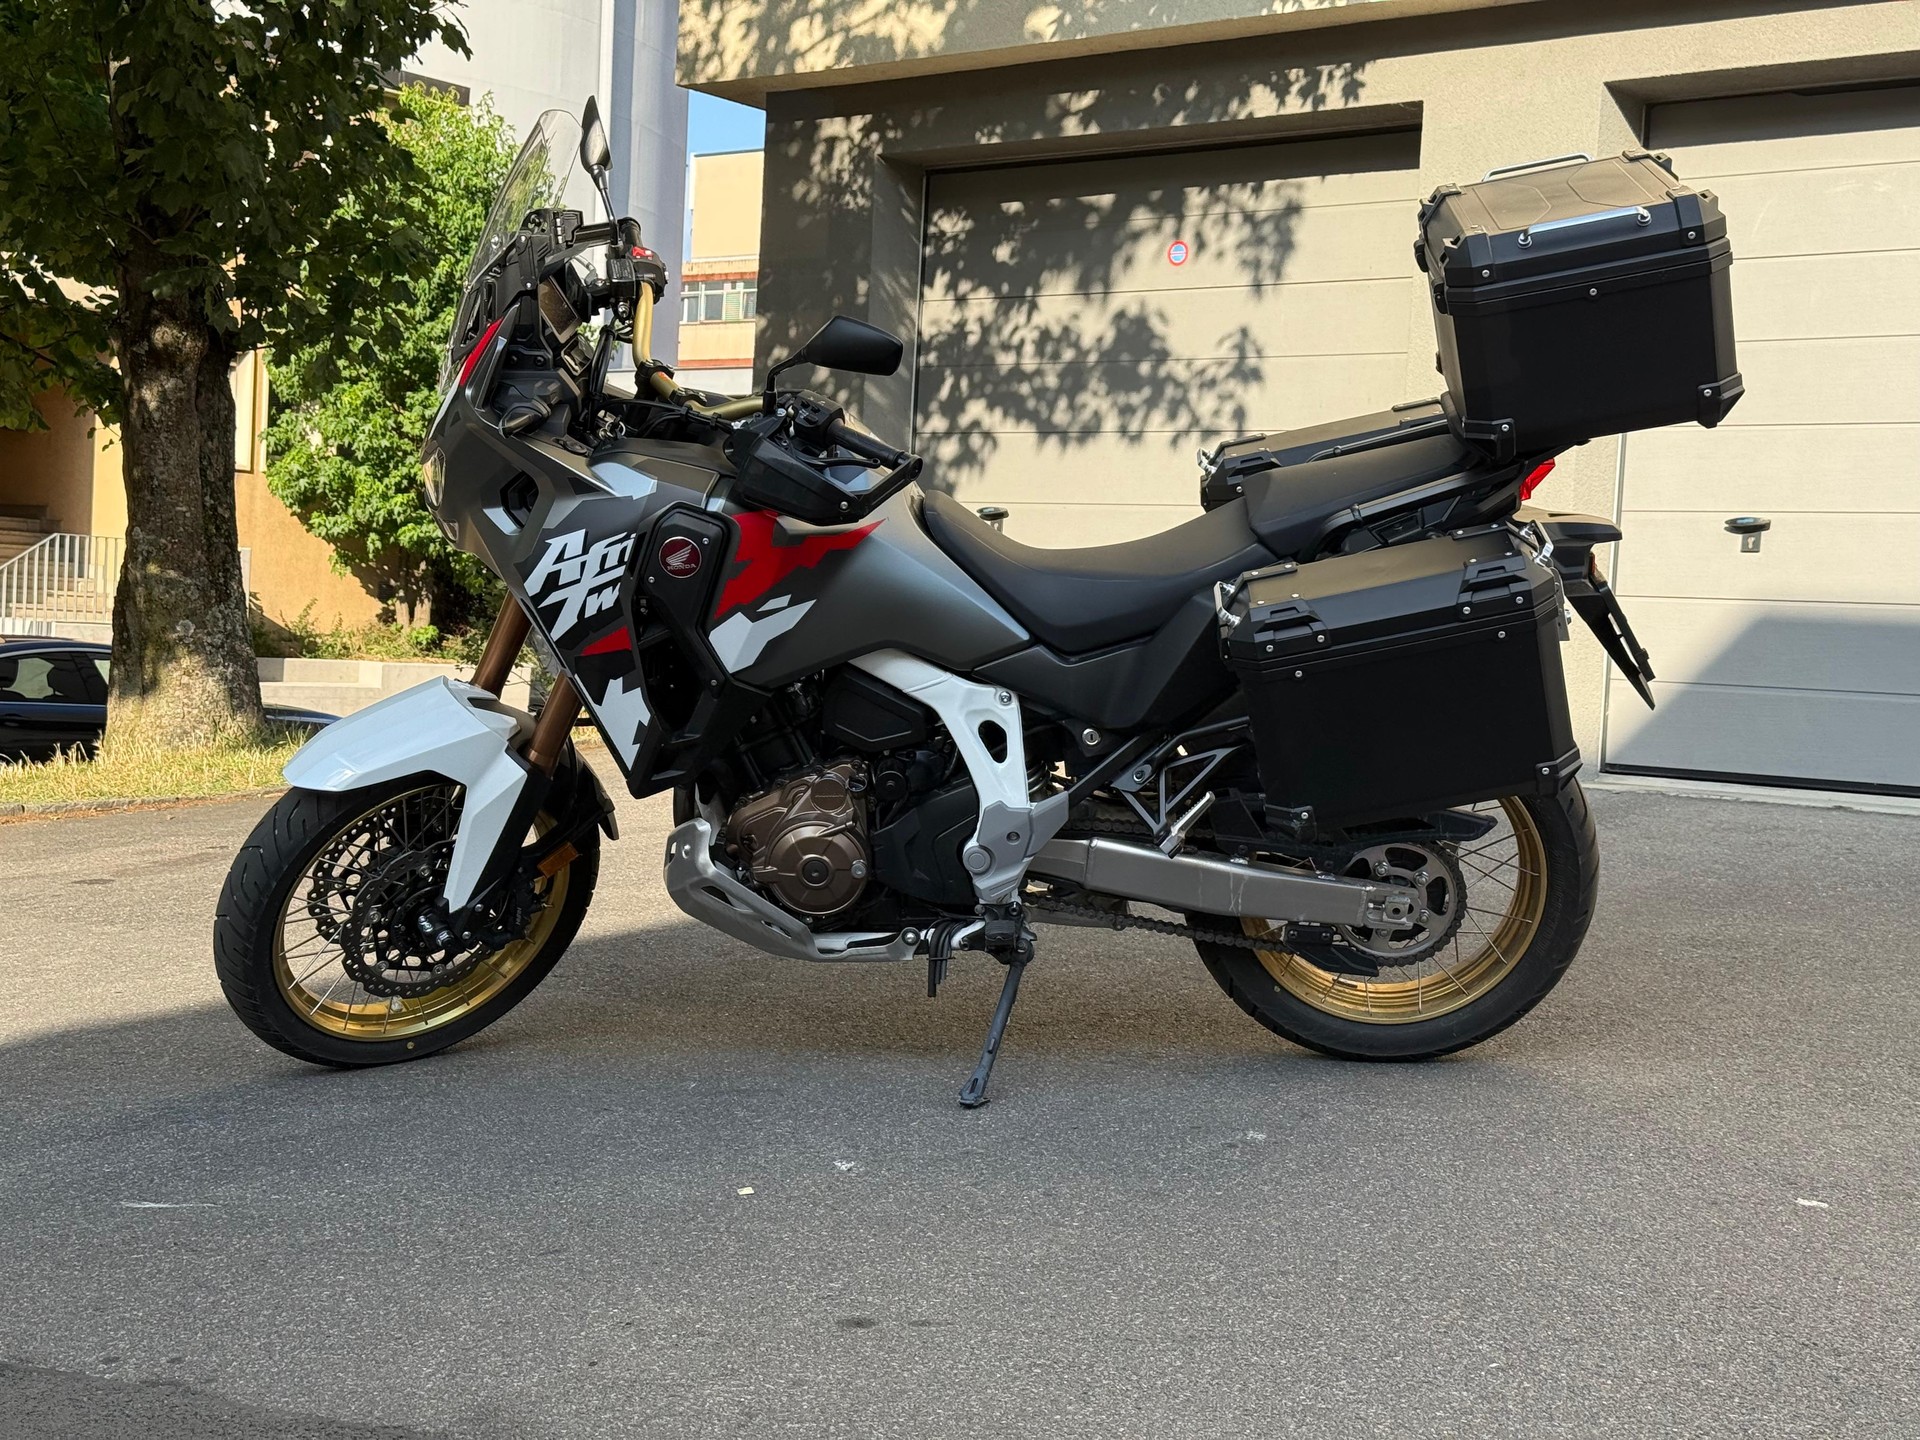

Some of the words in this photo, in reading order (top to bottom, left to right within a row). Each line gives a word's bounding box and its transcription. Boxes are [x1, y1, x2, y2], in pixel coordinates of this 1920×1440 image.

[523, 528, 637, 597] Afri
[666, 563, 697, 571] HONDA
[537, 565, 626, 642] Tw
